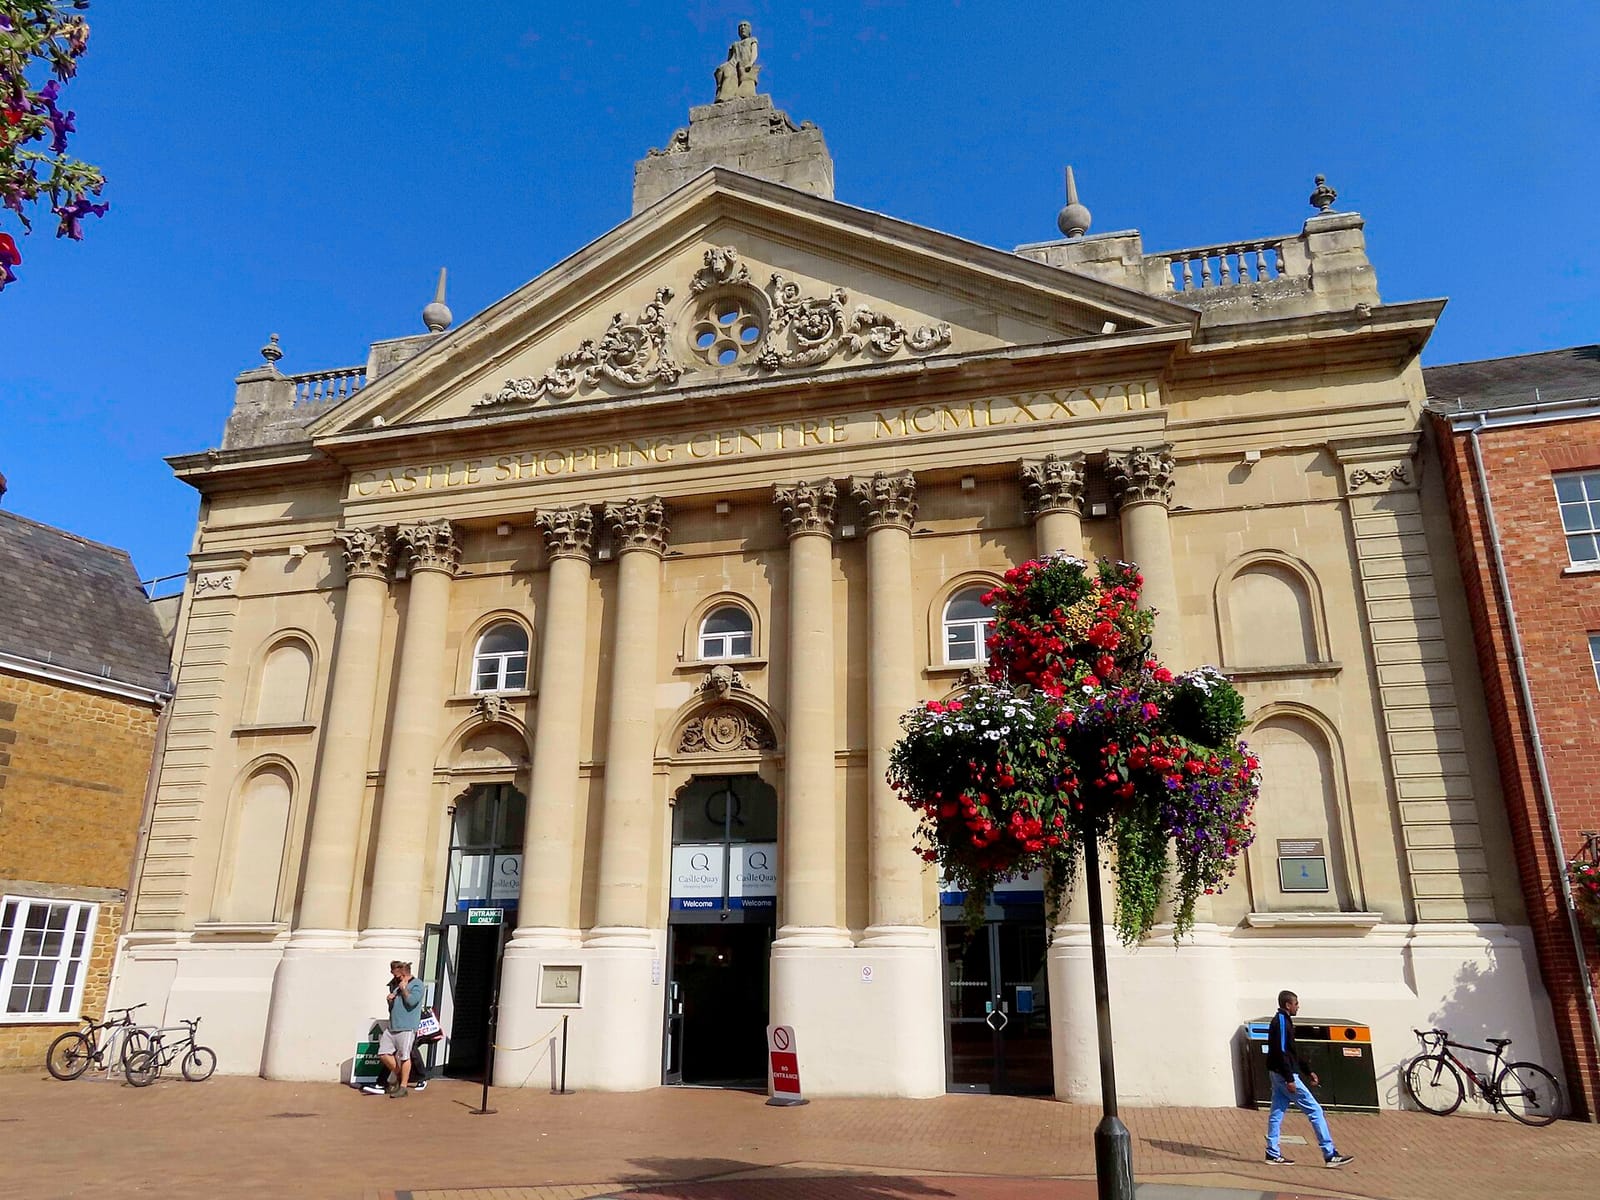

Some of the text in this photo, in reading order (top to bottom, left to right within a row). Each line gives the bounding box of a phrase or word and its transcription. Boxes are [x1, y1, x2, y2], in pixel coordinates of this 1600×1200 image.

[354, 381, 1150, 496] CASTLE SHOPPING CENTRE MCMLXXVII
[682, 900, 713, 908] Welcome
[741, 899, 772, 907] Welcome
[773, 1072, 798, 1080] ENTRANCE
